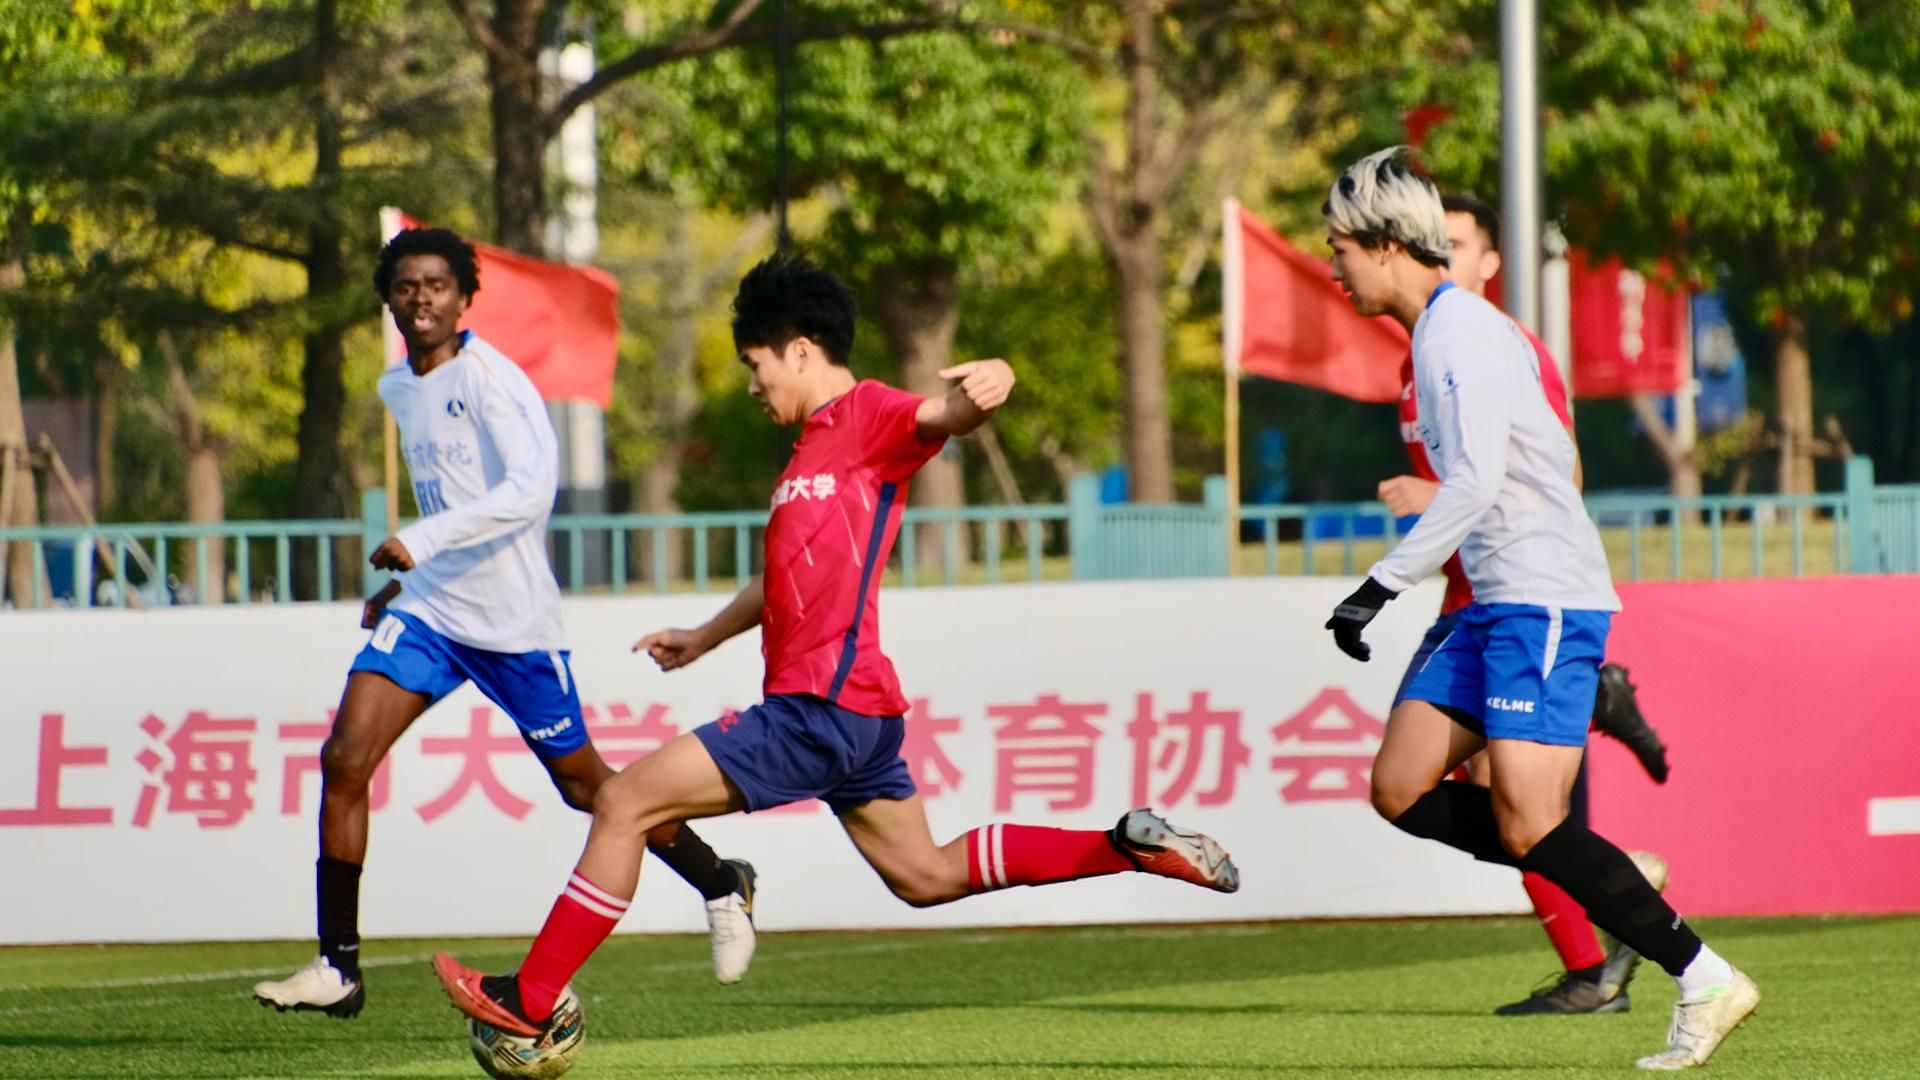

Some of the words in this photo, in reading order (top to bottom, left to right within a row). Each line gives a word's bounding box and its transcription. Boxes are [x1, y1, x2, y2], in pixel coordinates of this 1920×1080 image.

[0, 687, 1388, 829] 上海市大学体育协会
